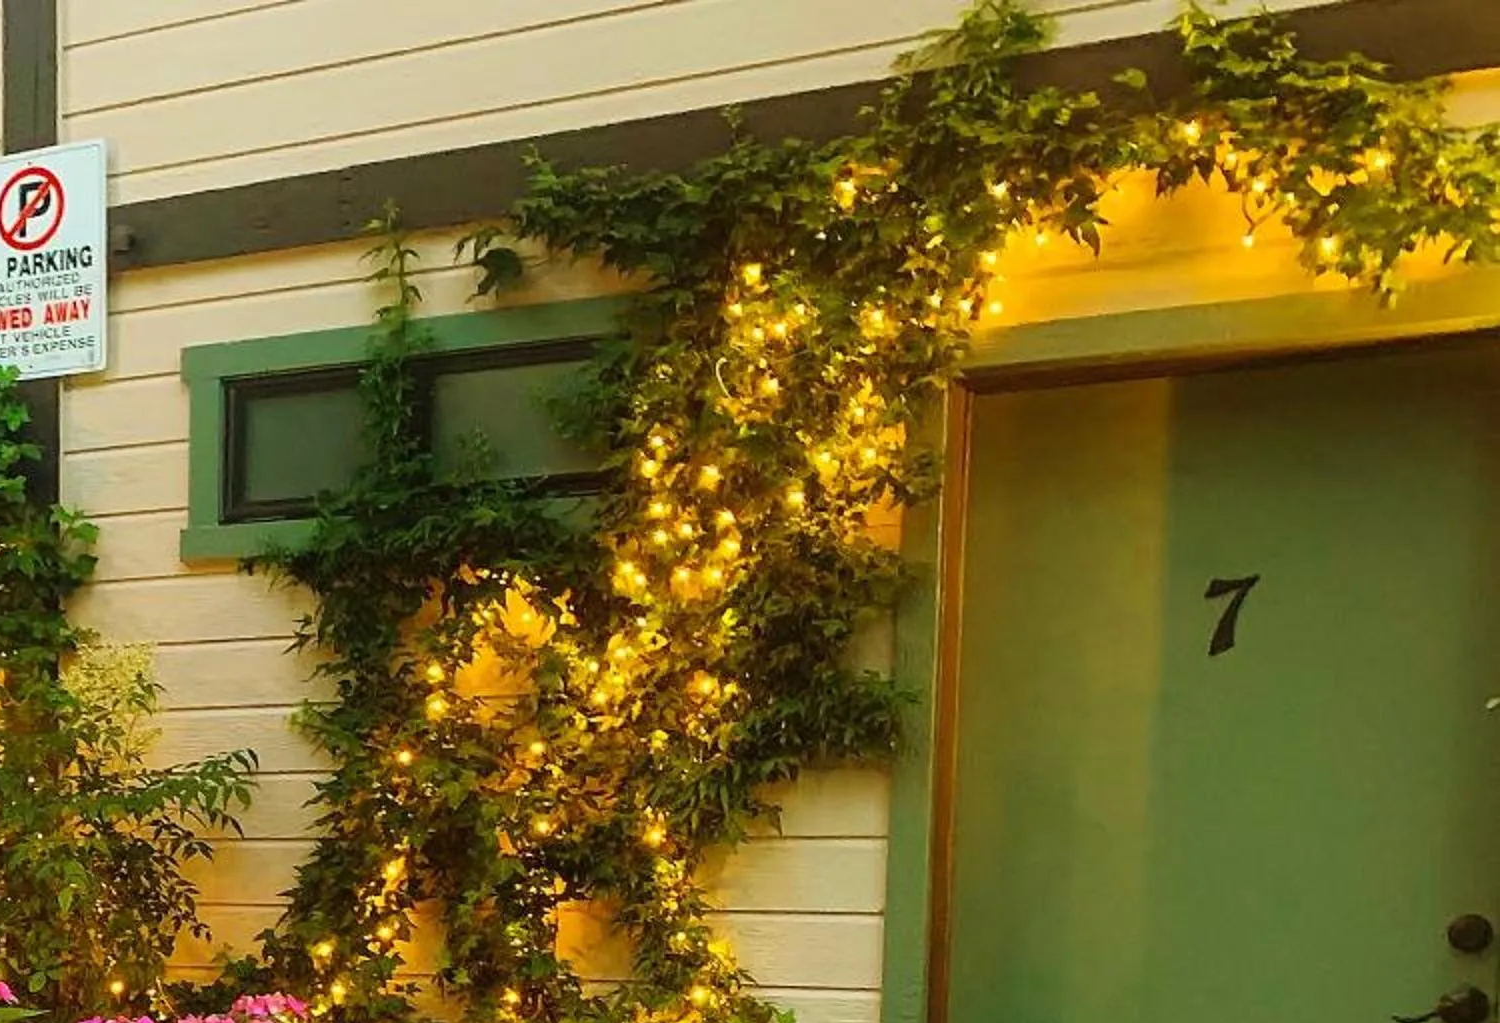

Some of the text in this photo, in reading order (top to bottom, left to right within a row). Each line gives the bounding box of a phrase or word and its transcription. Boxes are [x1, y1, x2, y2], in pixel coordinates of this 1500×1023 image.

[7, 245, 93, 278] PARKING
[37, 287, 69, 302] WILL
[73, 283, 93, 297] BE
[43, 299, 91, 325] AWAY
[13, 325, 71, 342] VEHICLE
[32, 335, 95, 355] EXPENSE
[1204, 573, 1261, 656] 7
